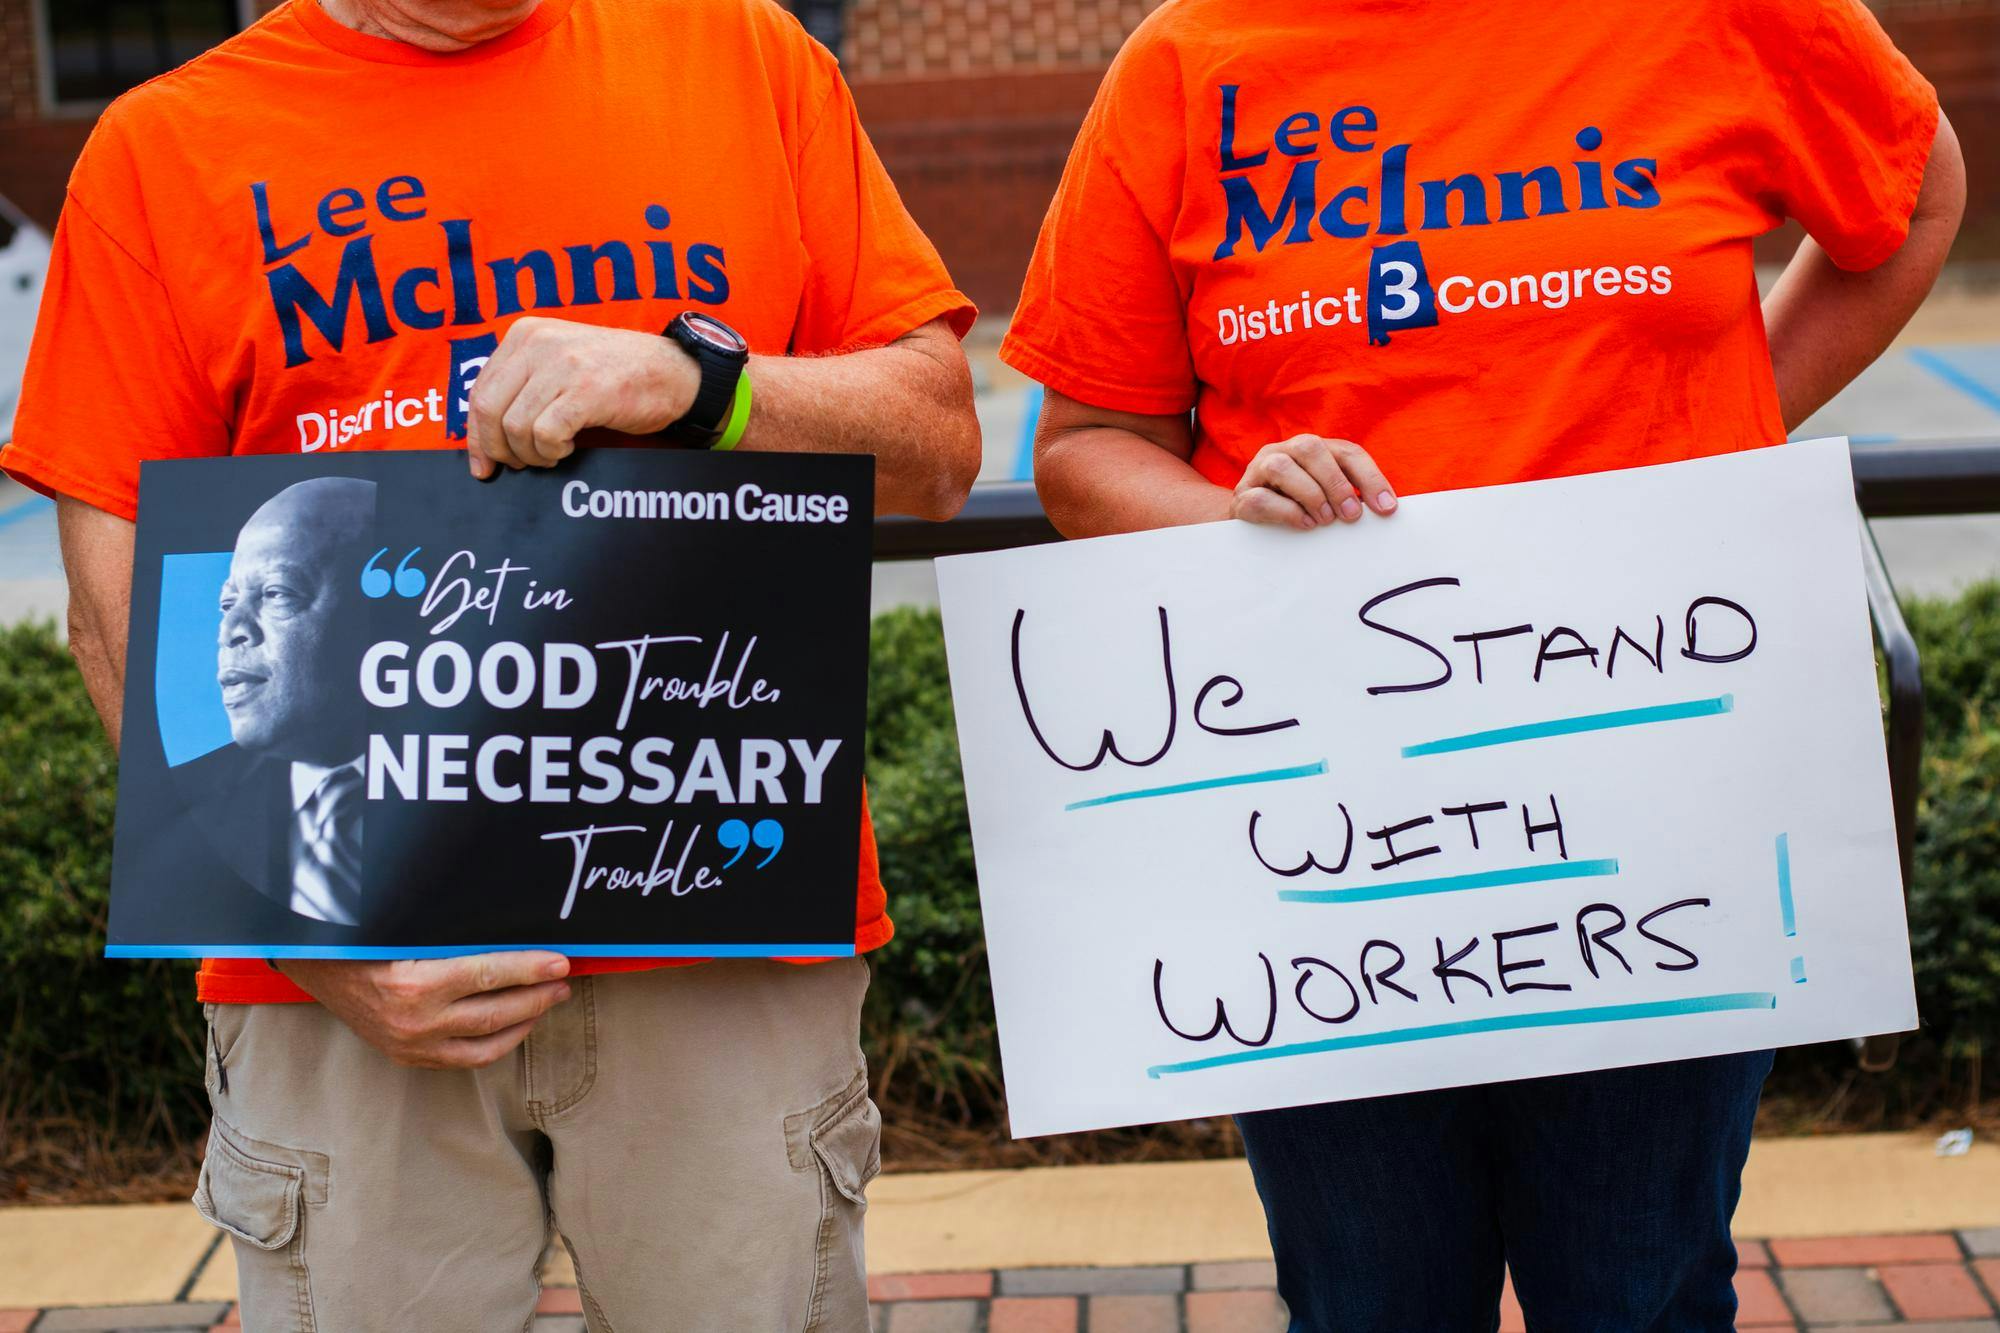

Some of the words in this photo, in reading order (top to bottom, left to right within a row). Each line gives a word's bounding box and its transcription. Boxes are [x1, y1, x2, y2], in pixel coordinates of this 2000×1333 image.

[1218, 85, 1379, 172] Lee
[249, 173, 427, 265] Lee
[1213, 126, 1661, 261] McInnis
[264, 204, 731, 369] McInnis
[1218, 287, 1361, 346] District
[1379, 260, 1421, 320] 3
[1437, 264, 1673, 314] Congress
[561, 480, 730, 521] Common
[734, 483, 850, 523] Cause
[522, 579, 573, 611] in
[1357, 576, 1758, 697] STAND
[359, 640, 598, 710] GOOD
[366, 733, 843, 805] NECESSARY
[1248, 793, 1570, 879] WITH
[1152, 897, 1711, 1048] WORKERS
